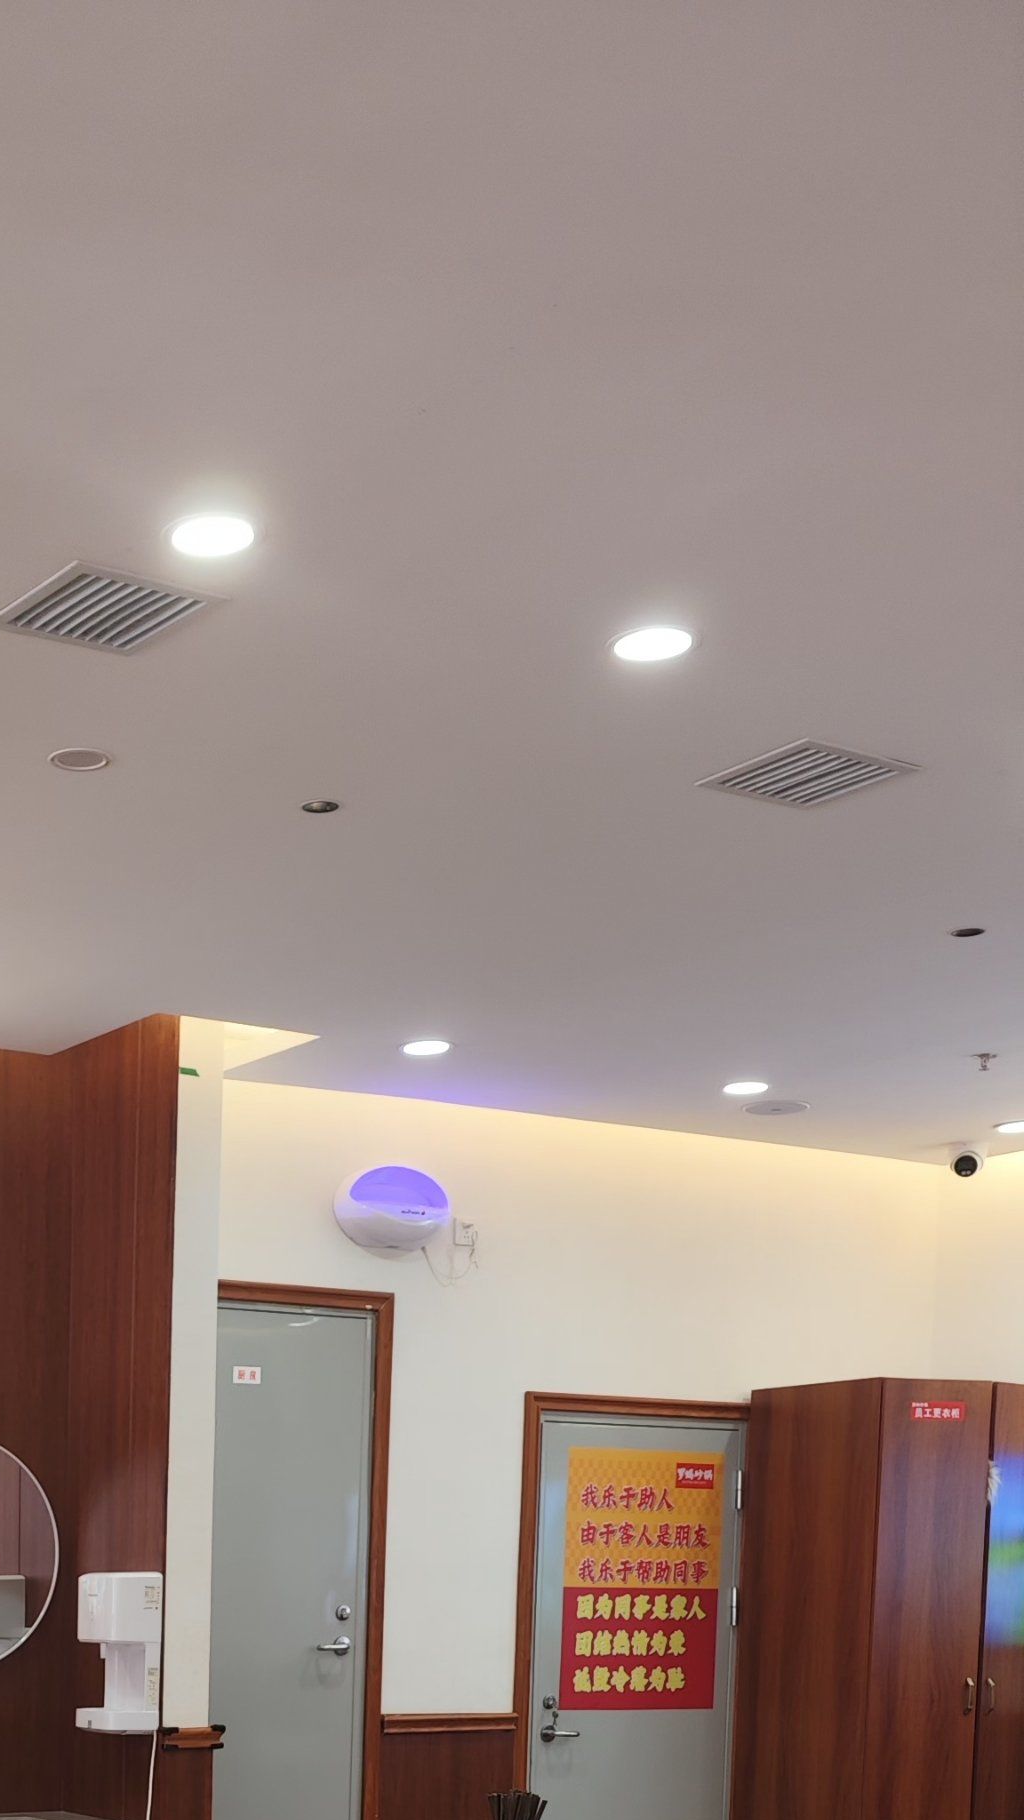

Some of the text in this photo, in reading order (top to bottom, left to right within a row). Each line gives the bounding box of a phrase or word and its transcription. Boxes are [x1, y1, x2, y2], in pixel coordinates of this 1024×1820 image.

[581, 1483, 675, 1511] 我乐于助人
[580, 1521, 711, 1549] 由于客人是朋友
[578, 1557, 710, 1586] 我乐于帮助同事
